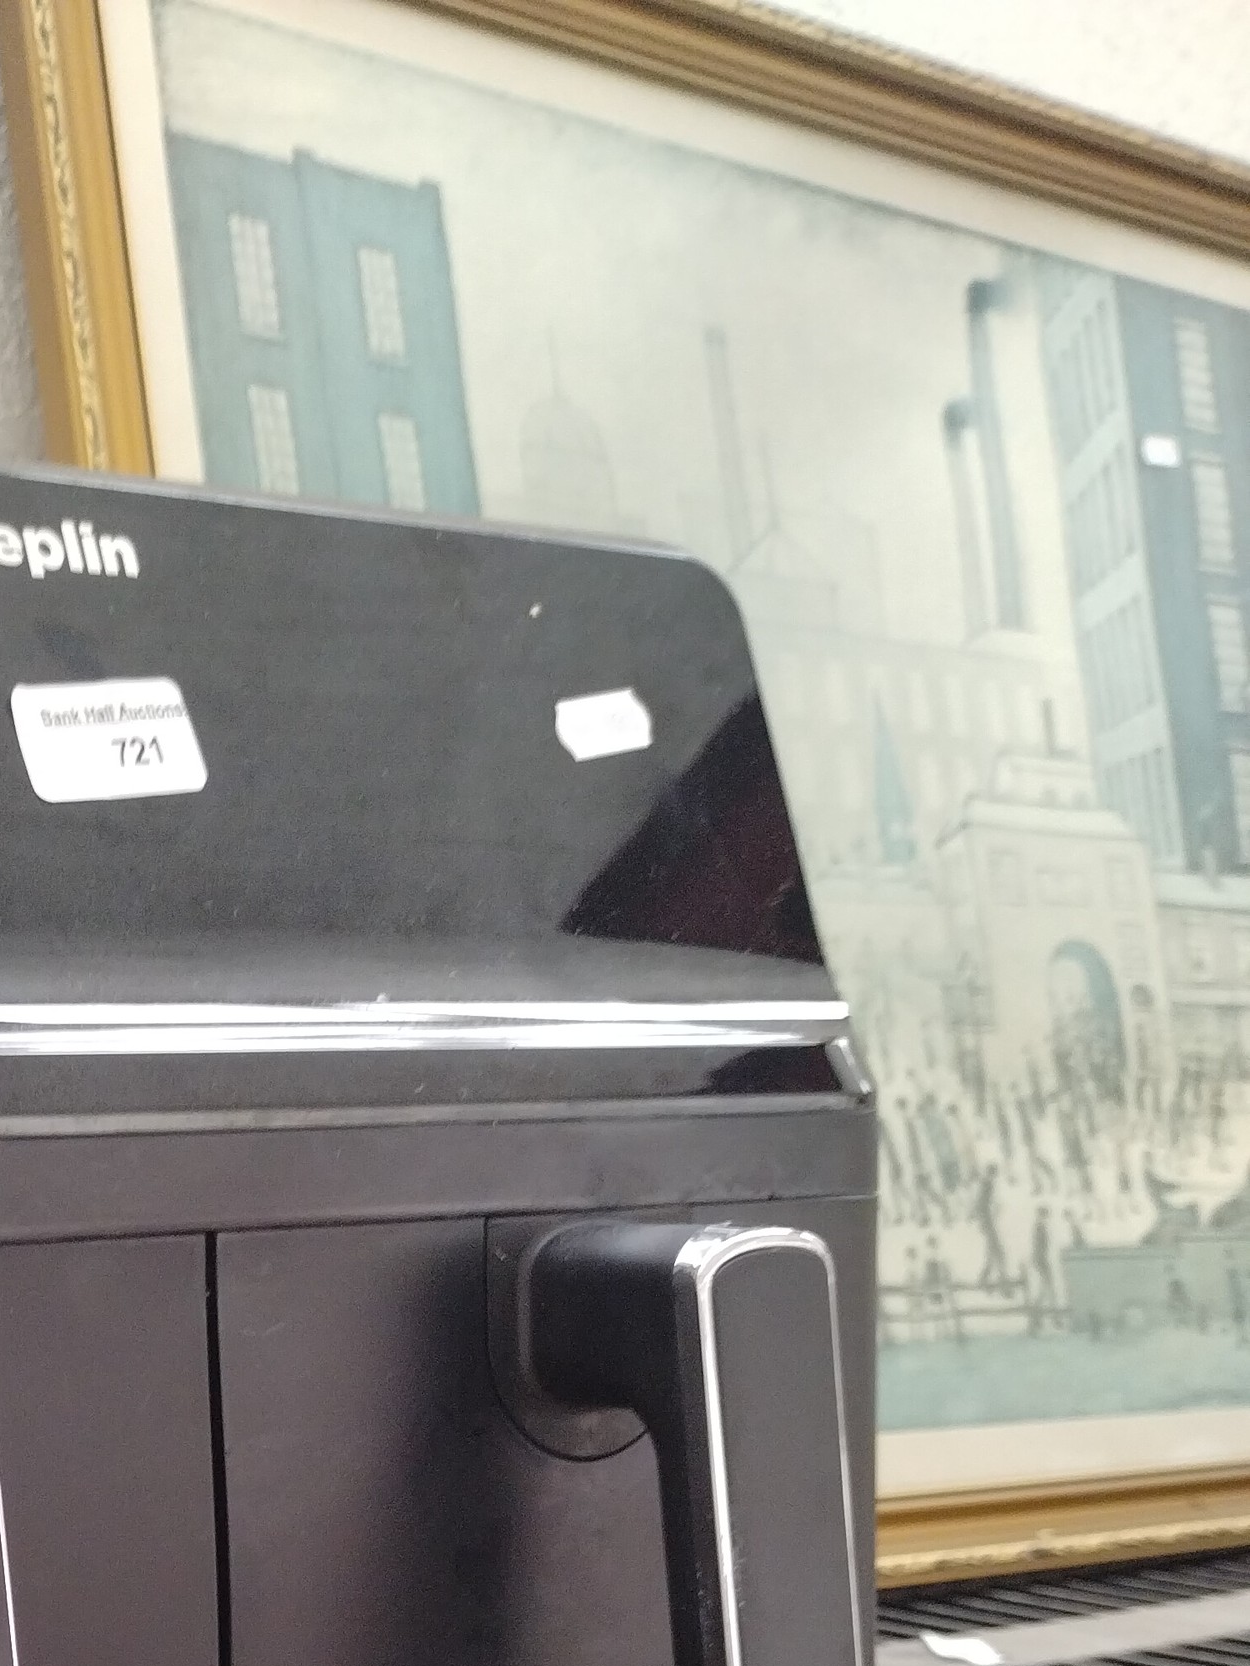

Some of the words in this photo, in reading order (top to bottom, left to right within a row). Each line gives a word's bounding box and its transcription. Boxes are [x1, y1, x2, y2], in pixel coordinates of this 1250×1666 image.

[40, 708, 82, 728] Bank
[84, 703, 116, 724] Hall
[110, 735, 164, 768] 721
